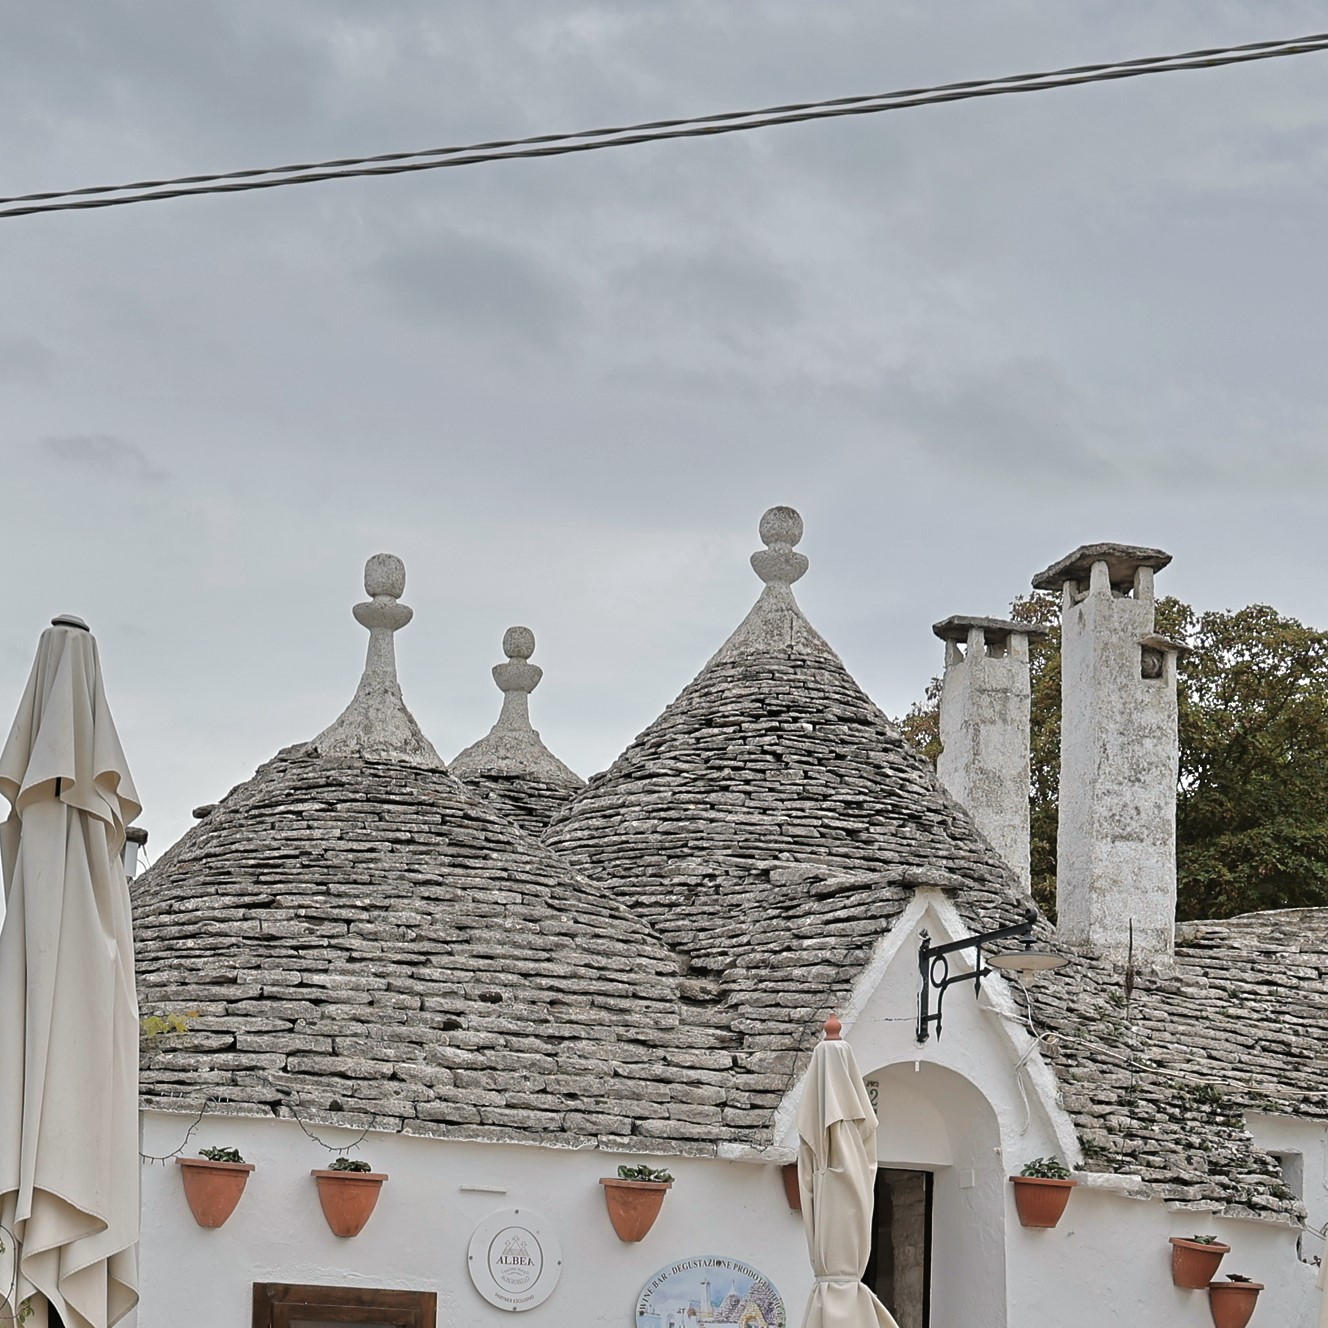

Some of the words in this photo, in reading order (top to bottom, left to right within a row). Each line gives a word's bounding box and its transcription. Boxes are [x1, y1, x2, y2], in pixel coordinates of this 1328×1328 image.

[496, 1255, 535, 1266] ALBEA
[639, 1286, 654, 1311] WINE
[653, 1272, 669, 1288] BAR
[671, 1259, 732, 1275] DEGUSTAZINE
